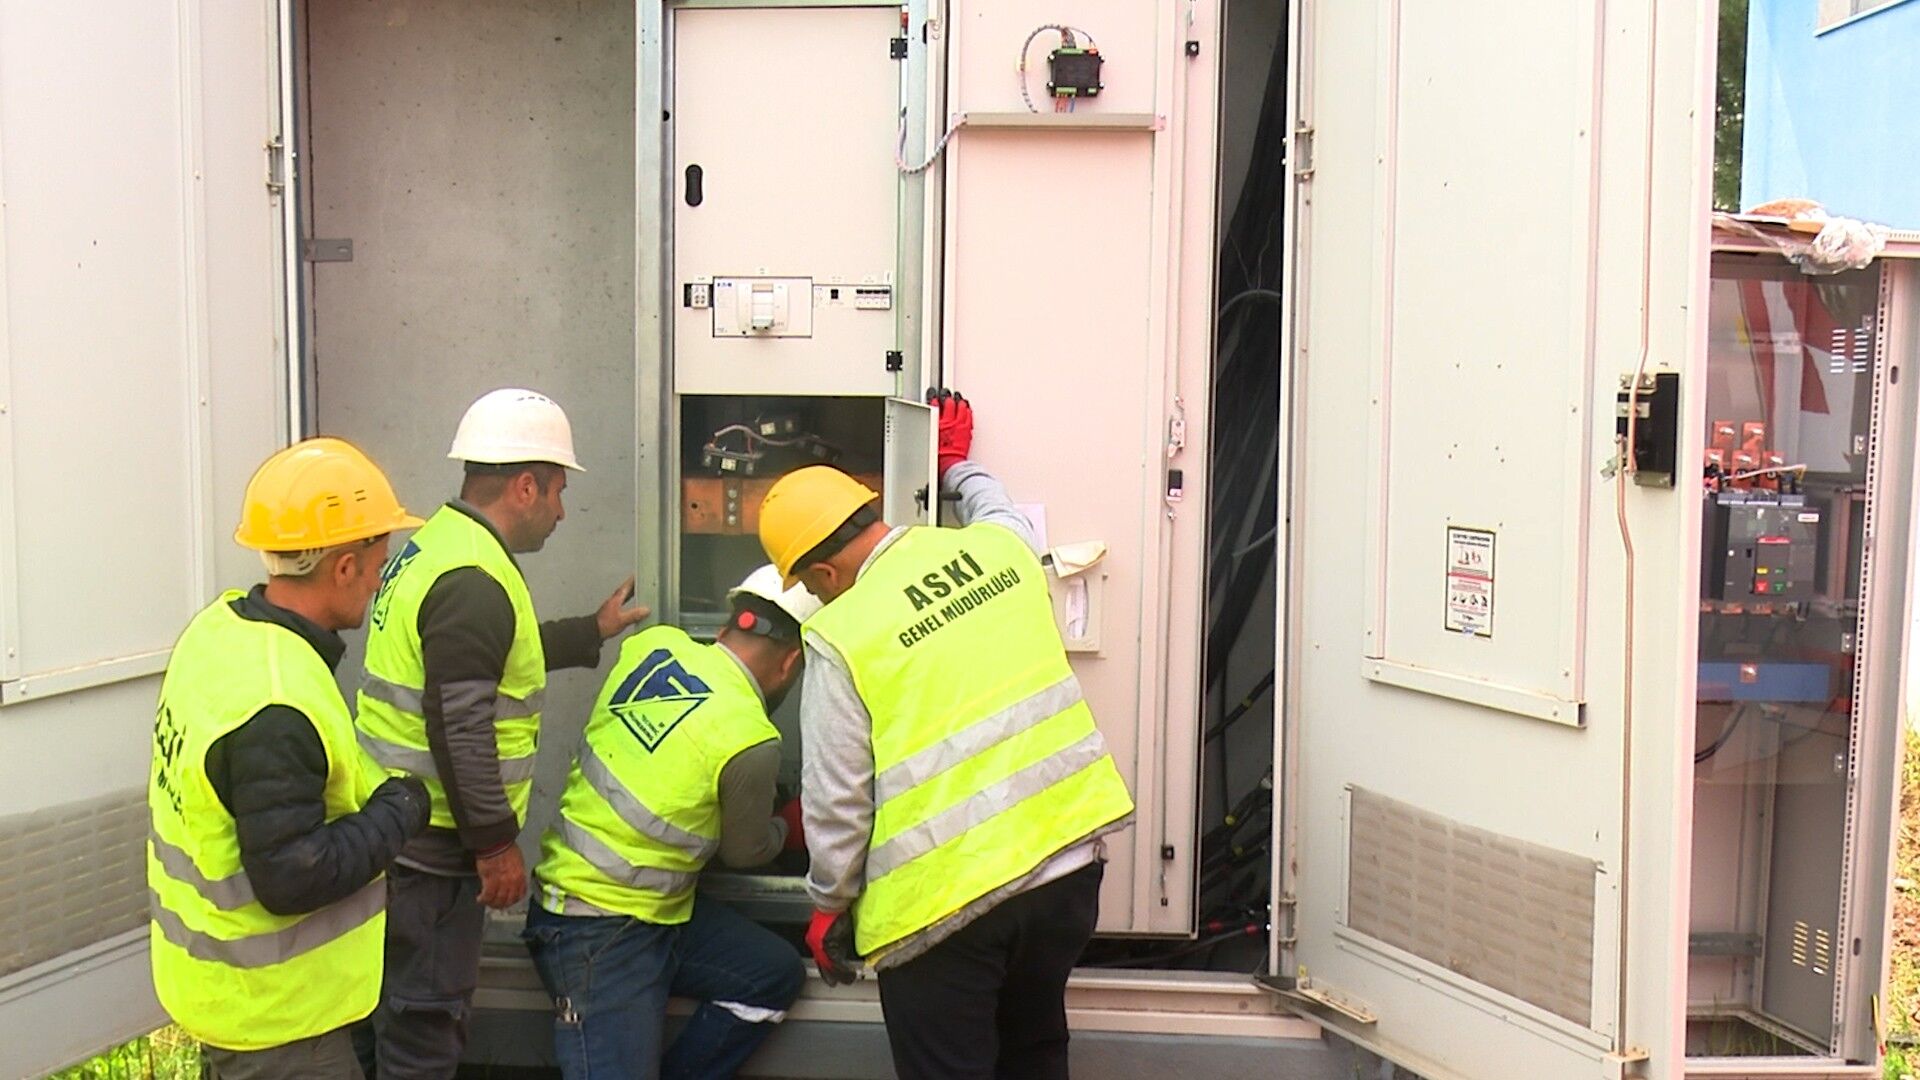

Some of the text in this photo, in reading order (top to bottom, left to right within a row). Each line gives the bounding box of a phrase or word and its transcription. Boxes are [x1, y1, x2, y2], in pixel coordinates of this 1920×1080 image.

[898, 567, 1021, 648] GENEL MÜDÜRLÜĞÜ
[903, 549, 985, 612] ASKİ
